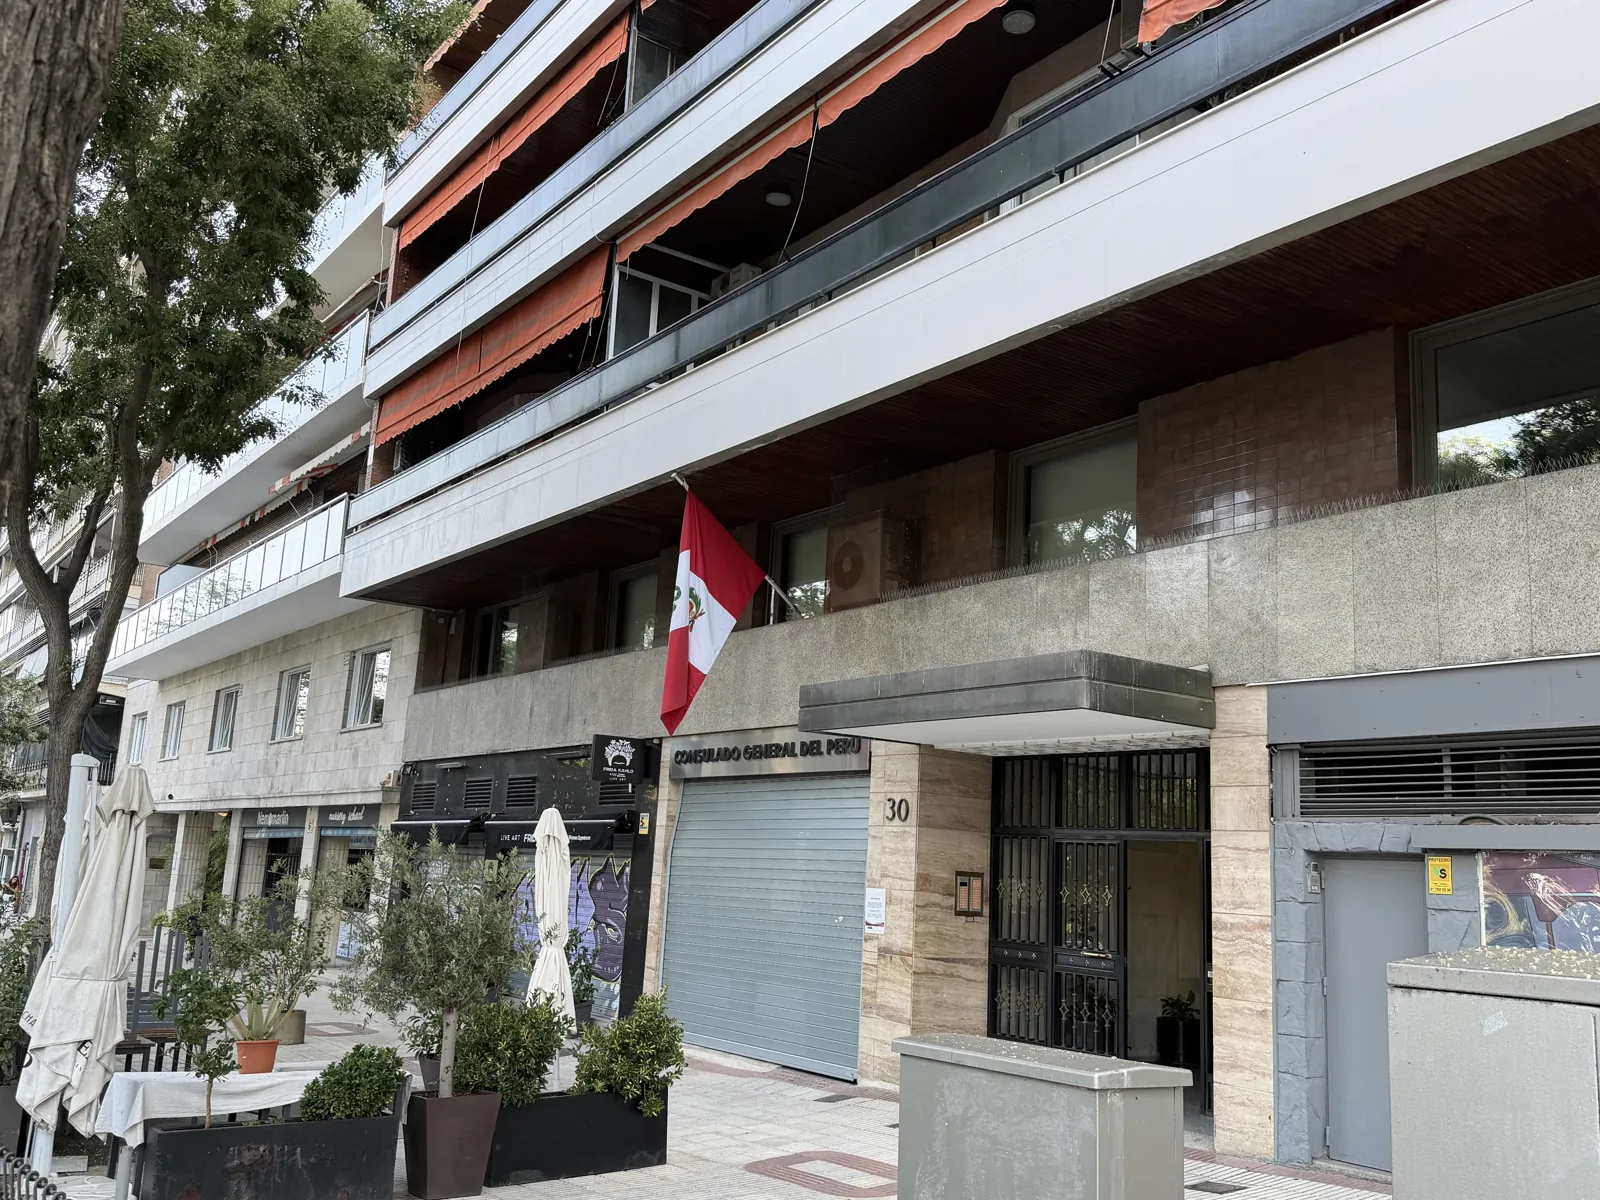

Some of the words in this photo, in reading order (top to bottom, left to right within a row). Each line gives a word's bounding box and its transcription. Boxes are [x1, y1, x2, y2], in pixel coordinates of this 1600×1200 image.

[674, 745, 741, 765] CONSULADO
[743, 741, 798, 761] GENERAL
[799, 739, 824, 757] DEL
[328, 812, 347, 825] nursery
[347, 805, 365, 820] school
[885, 797, 910, 823] 30
[523, 833, 537, 843] FRID
